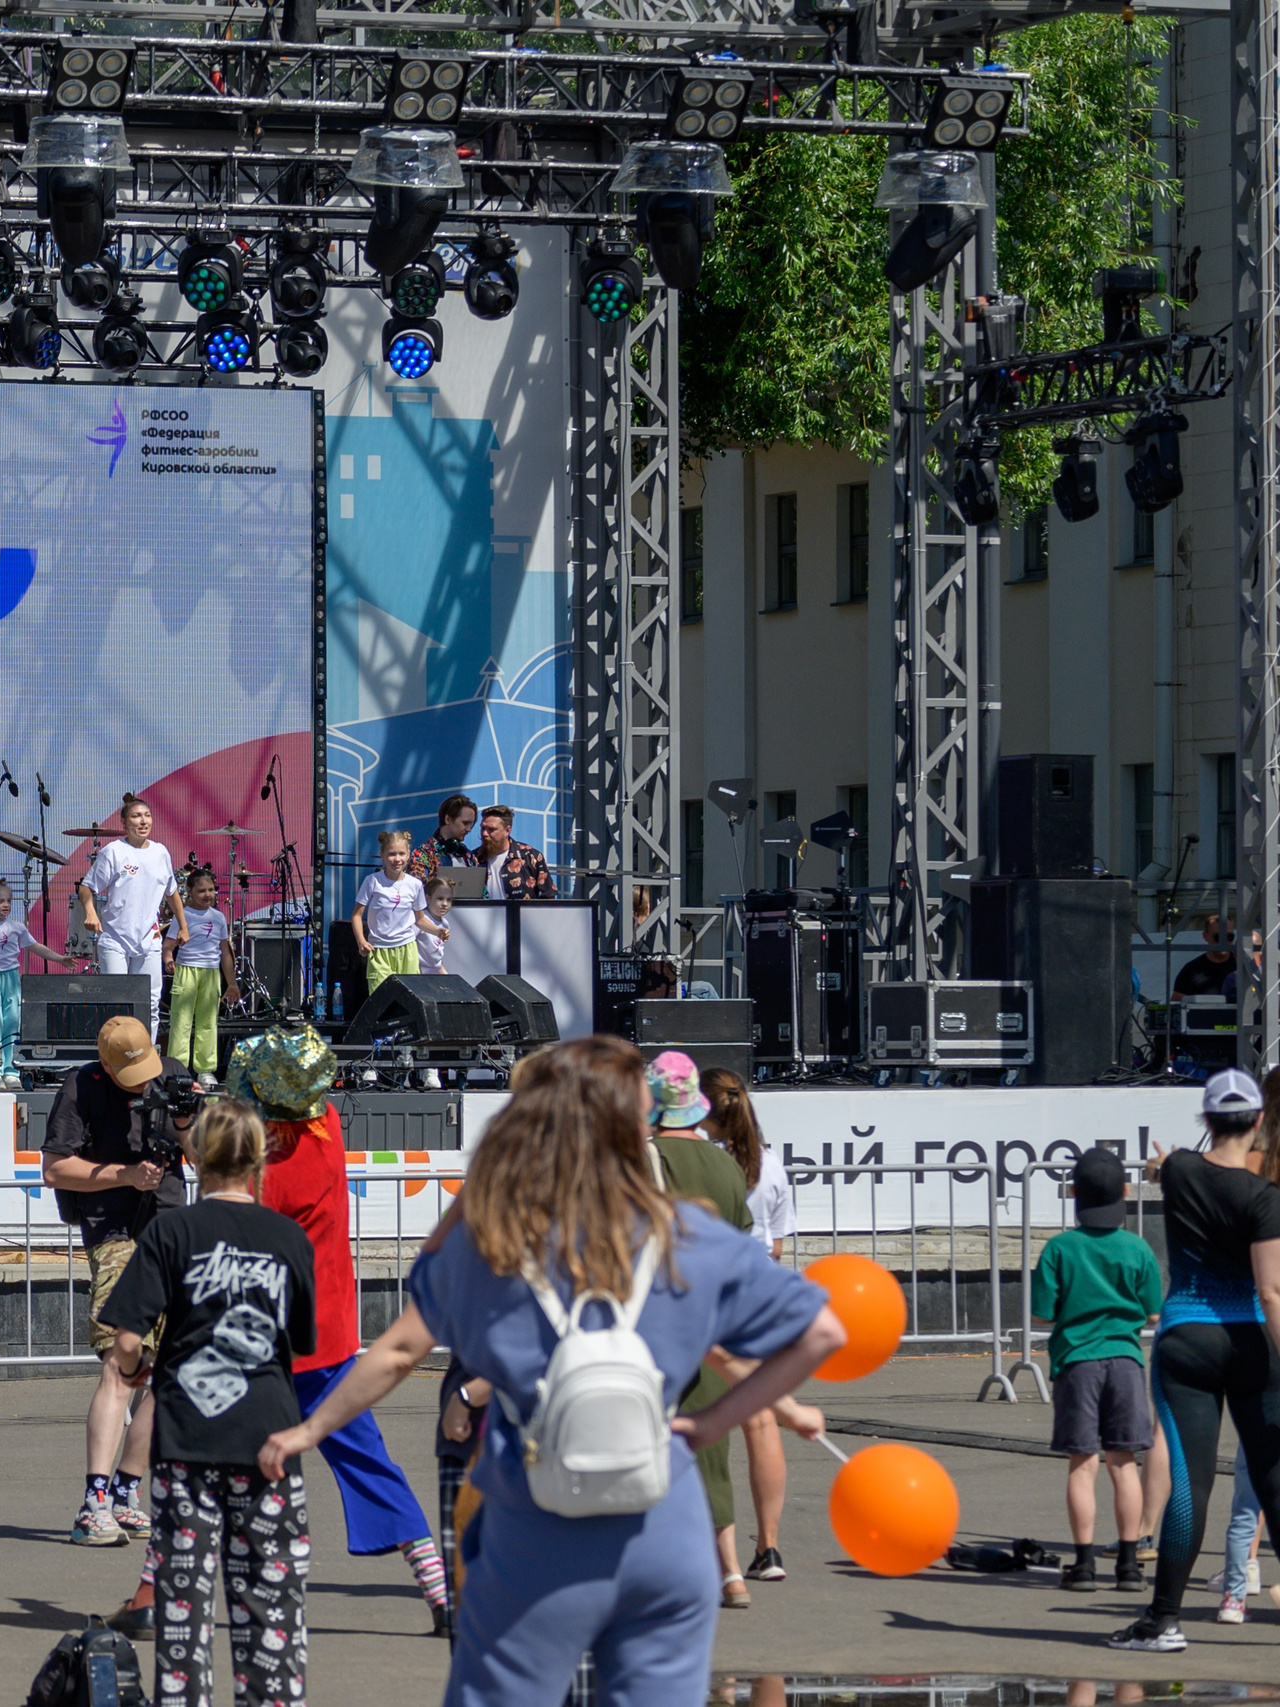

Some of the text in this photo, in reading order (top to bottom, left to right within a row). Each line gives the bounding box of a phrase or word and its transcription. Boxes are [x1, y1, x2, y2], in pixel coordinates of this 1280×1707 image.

[141, 409, 189, 421] РФСОО
[141, 427, 220, 440] «Федерация
[141, 444, 259, 459] фитнес-аэробики
[141, 461, 277, 476] Кировской области»
[606, 982, 637, 993] SOUND
